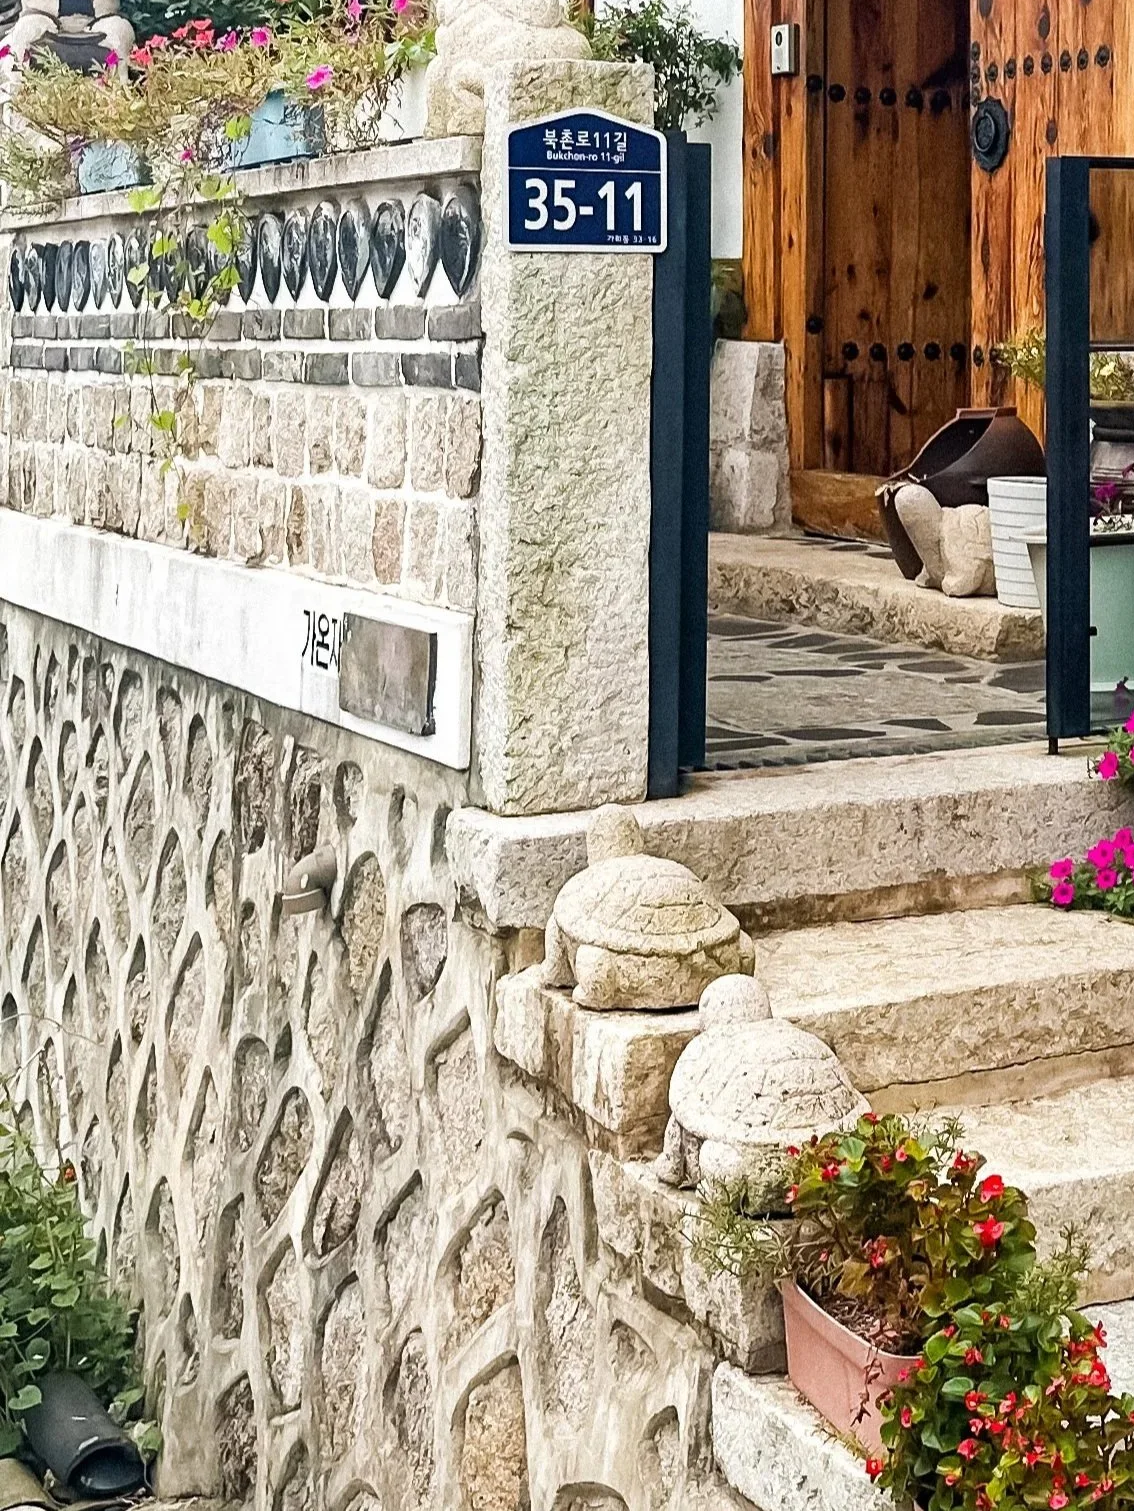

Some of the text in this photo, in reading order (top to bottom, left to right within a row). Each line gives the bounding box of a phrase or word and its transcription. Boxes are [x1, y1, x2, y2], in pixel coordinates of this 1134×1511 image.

[542, 128, 627, 152] 북촌로11길
[546, 150, 625, 164] Bukchon-ro 11-gil
[524, 177, 642, 231] 35-11
